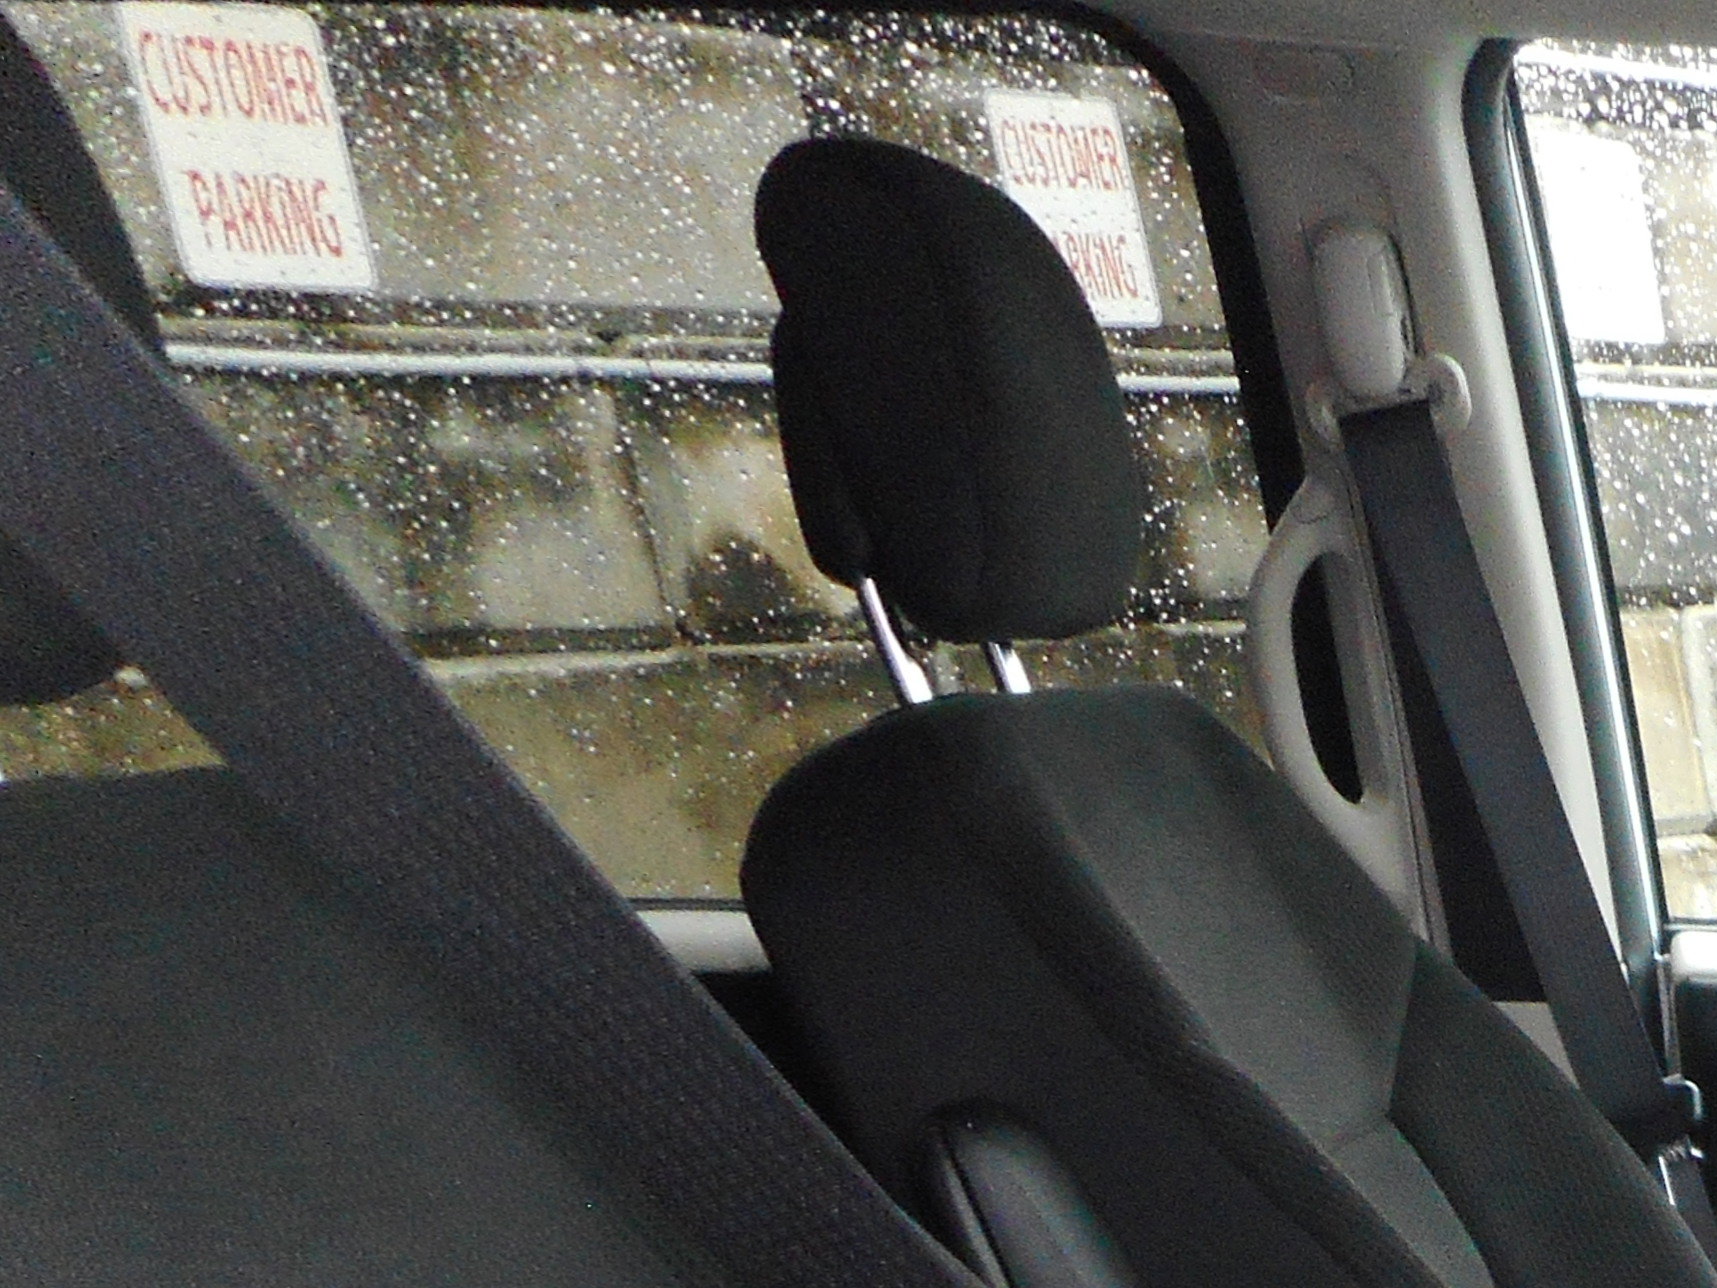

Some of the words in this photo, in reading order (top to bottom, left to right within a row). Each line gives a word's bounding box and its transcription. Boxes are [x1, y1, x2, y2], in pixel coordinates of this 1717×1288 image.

[138, 29, 331, 127] CUSTOMER
[1000, 119, 1127, 192] CUSTOMER
[183, 169, 344, 257] PARKING
[1051, 231, 1139, 299] RKING
